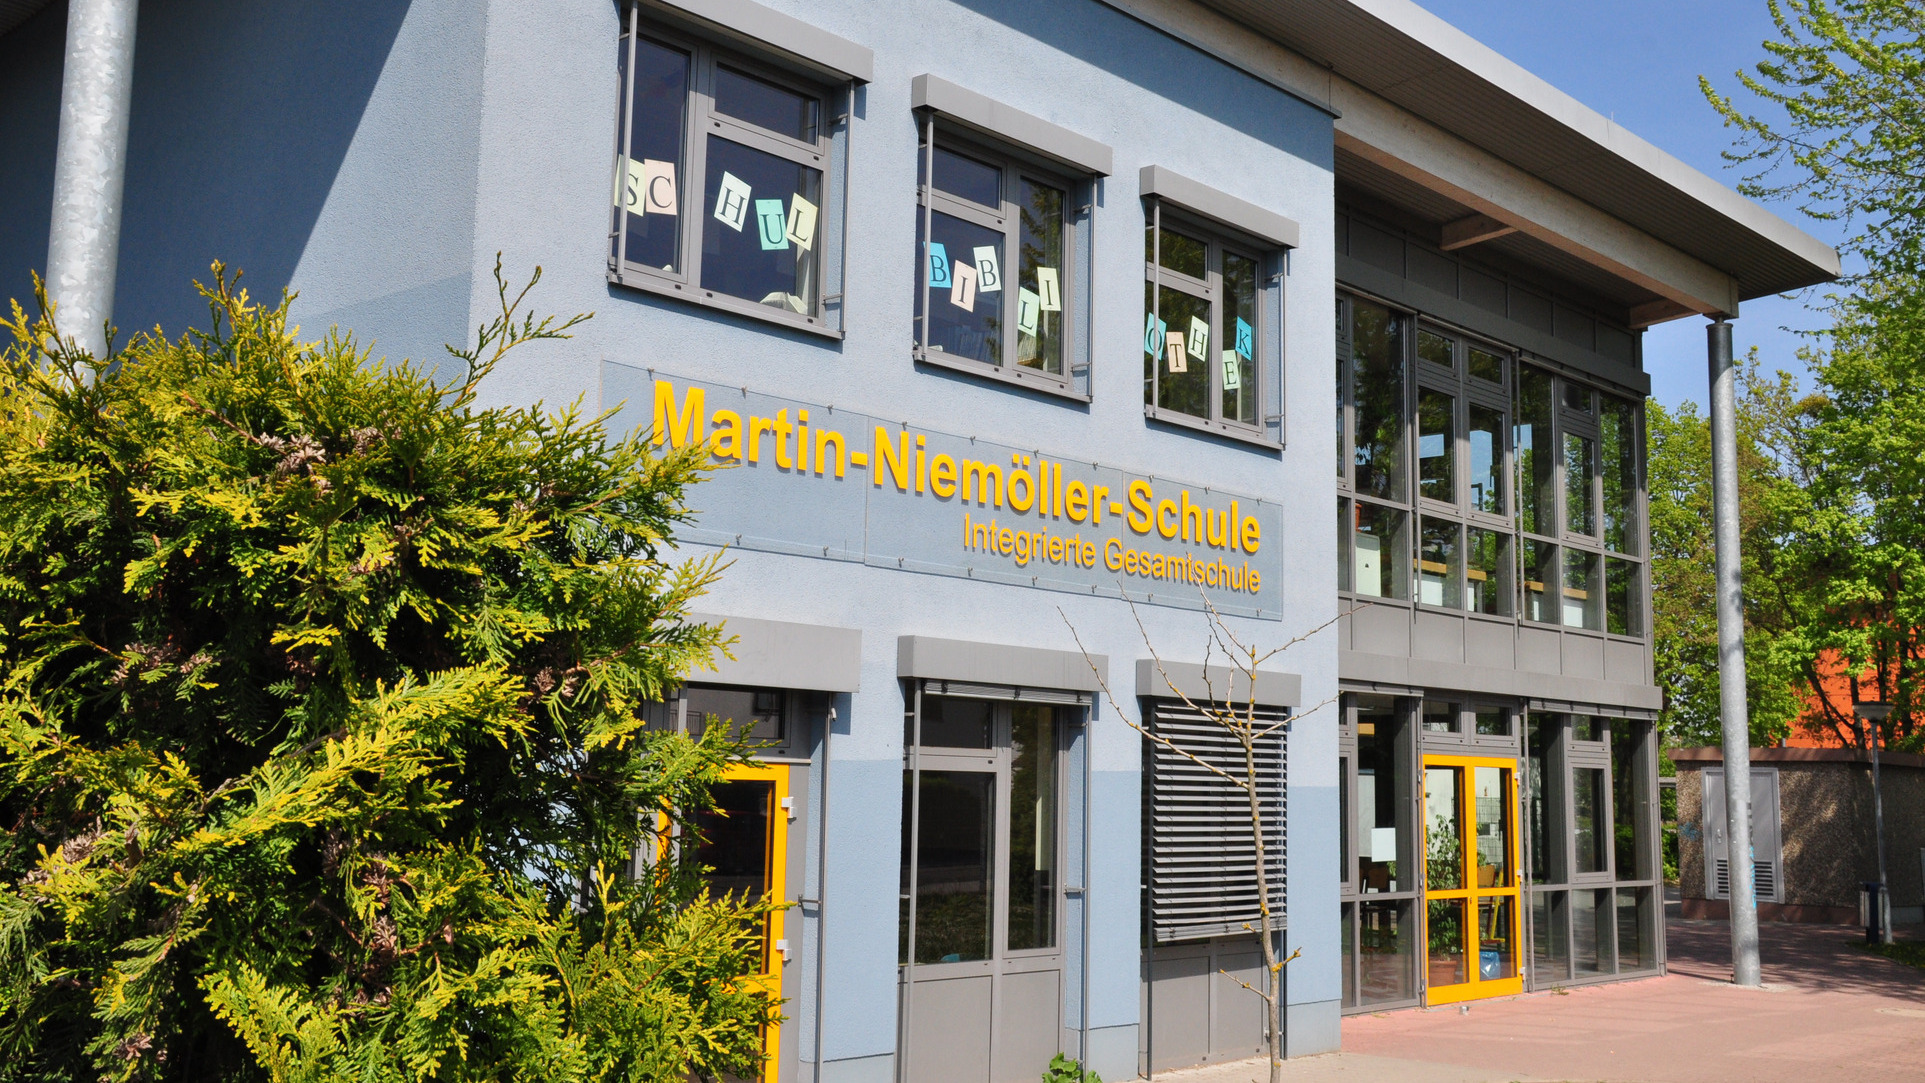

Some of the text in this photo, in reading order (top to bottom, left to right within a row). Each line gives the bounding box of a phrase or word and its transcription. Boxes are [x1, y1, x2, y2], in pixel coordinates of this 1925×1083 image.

[653, 379, 1261, 554] Martin-Niemöller-Schule
[963, 512, 1262, 594] Integrierte Gesamtschule
